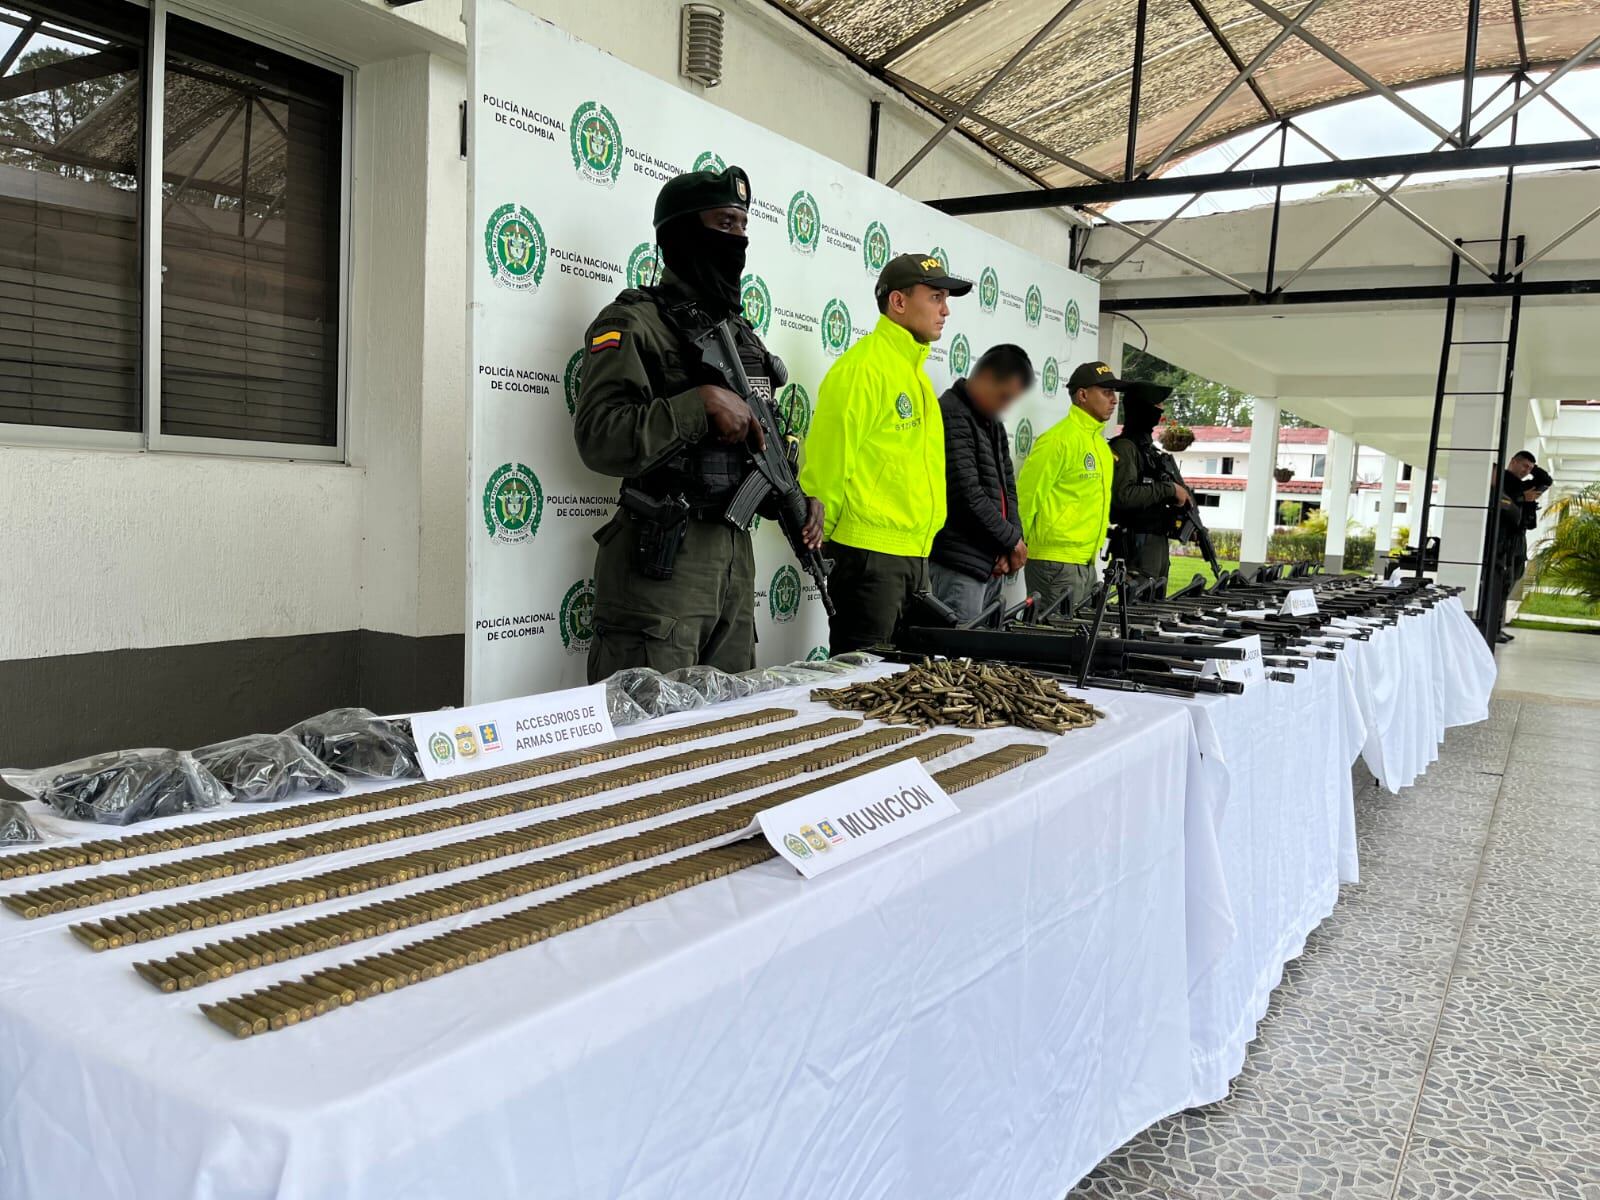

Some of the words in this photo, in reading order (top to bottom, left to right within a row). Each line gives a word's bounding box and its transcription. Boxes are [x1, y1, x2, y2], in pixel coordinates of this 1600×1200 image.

[483, 94, 519, 114] POLICÍA
[521, 107, 566, 132] NACIONAL
[495, 112, 507, 124] DE
[509, 117, 555, 141] COLOMBIA
[625, 147, 653, 164] POLICÍA
[633, 163, 643, 173] DE
[644, 167, 672, 183] COLOM
[751, 208, 778, 224] COLOMBIA
[758, 200, 785, 217] NACIONAL
[826, 236, 833, 244] DE
[550, 248, 582, 265] POLICÍA
[584, 256, 623, 274] NACIONAL
[560, 264, 572, 274] DE
[573, 267, 613, 284] COLOMBIA
[780, 319, 787, 327] DE
[479, 365, 515, 377] POLICÍA
[516, 370, 560, 383] NACIONAL
[491, 380, 503, 390] DE
[505, 382, 550, 395] COLOMBIA
[546, 495, 578, 505] POLICÍA
[579, 496, 619, 505] NACIONAL
[557, 508, 567, 517] DE
[569, 508, 608, 517] COLOMBIA
[476, 616, 511, 629] POLICÍA
[513, 612, 556, 625] NACIONAL
[487, 631, 499, 641] DE
[501, 626, 545, 639] COLOMBIA
[516, 708, 581, 733] ACCESORIOS
[582, 705, 596, 718] DE
[516, 732, 554, 751] ARMAS
[556, 729, 570, 742] DE
[570, 721, 604, 740] FUEGO
[837, 785, 934, 839] MUNICIÓN
